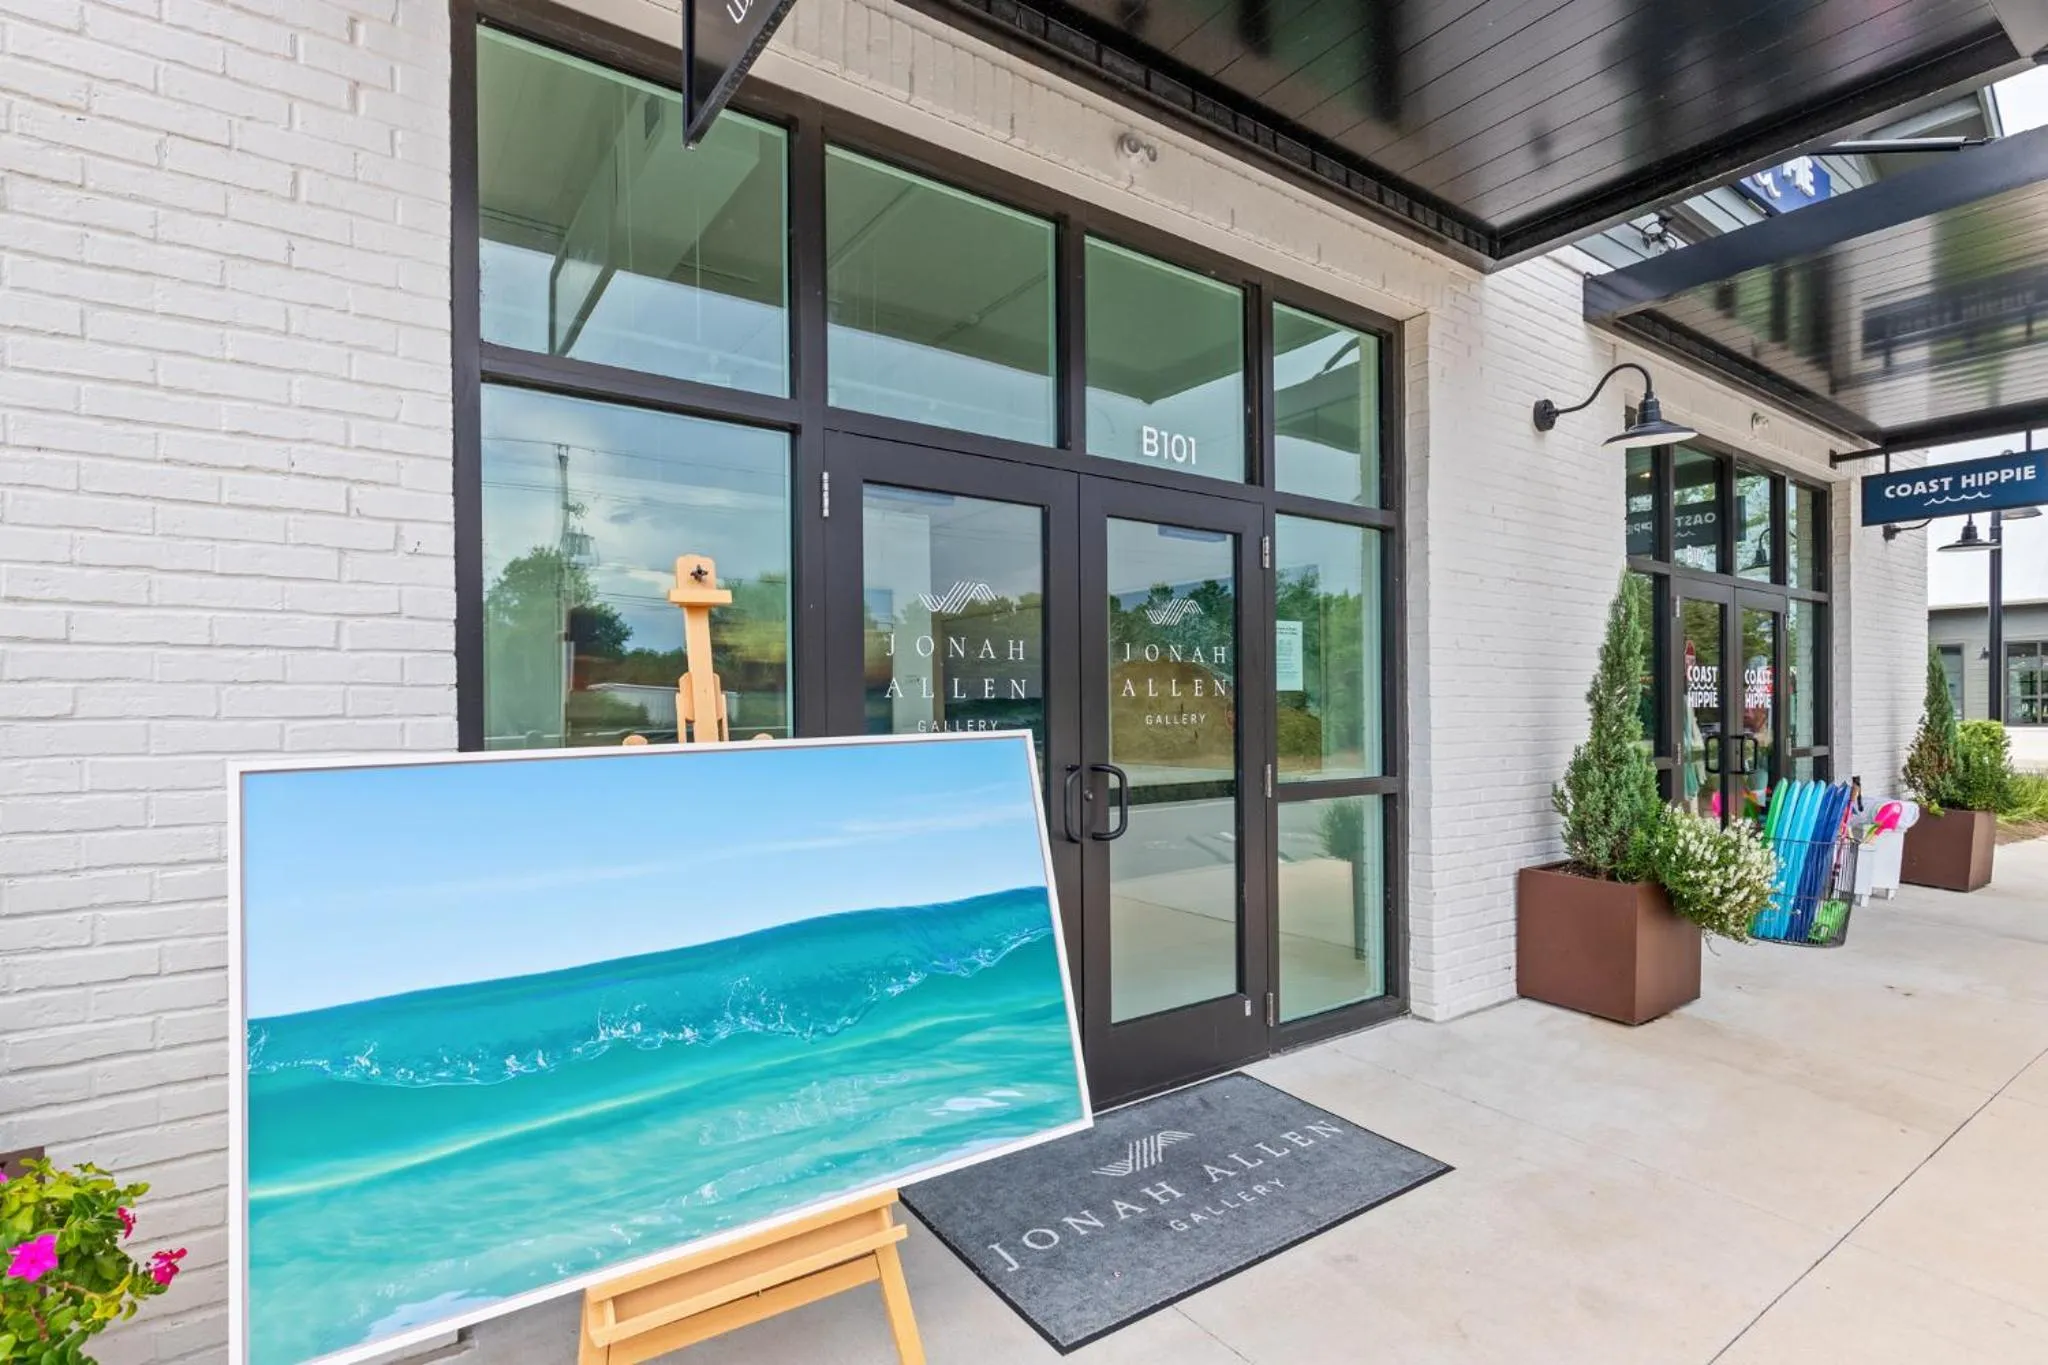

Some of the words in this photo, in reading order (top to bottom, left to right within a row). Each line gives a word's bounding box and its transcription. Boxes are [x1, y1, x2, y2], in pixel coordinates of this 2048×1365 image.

[1142, 425, 1196, 465] B101
[1884, 477, 1953, 499] COAST
[1961, 465, 2037, 489] HIPPIE
[884, 633, 1025, 660] JONAH
[1120, 643, 1226, 664] JONAH
[1686, 665, 1719, 683] COAST
[1744, 667, 1773, 685] COAST
[884, 677, 1027, 700] ALLEN
[1121, 678, 1227, 697] ALLEN
[1687, 691, 1720, 708] HIPPIE
[1744, 693, 1773, 709] HIPPIE
[917, 719, 999, 733] GALLERY
[1145, 713, 1207, 725] GALLERY
[987, 1180, 1186, 1272] JONAH
[1202, 1120, 1345, 1184] ALLEN
[1169, 1176, 1287, 1233] GALLERY
